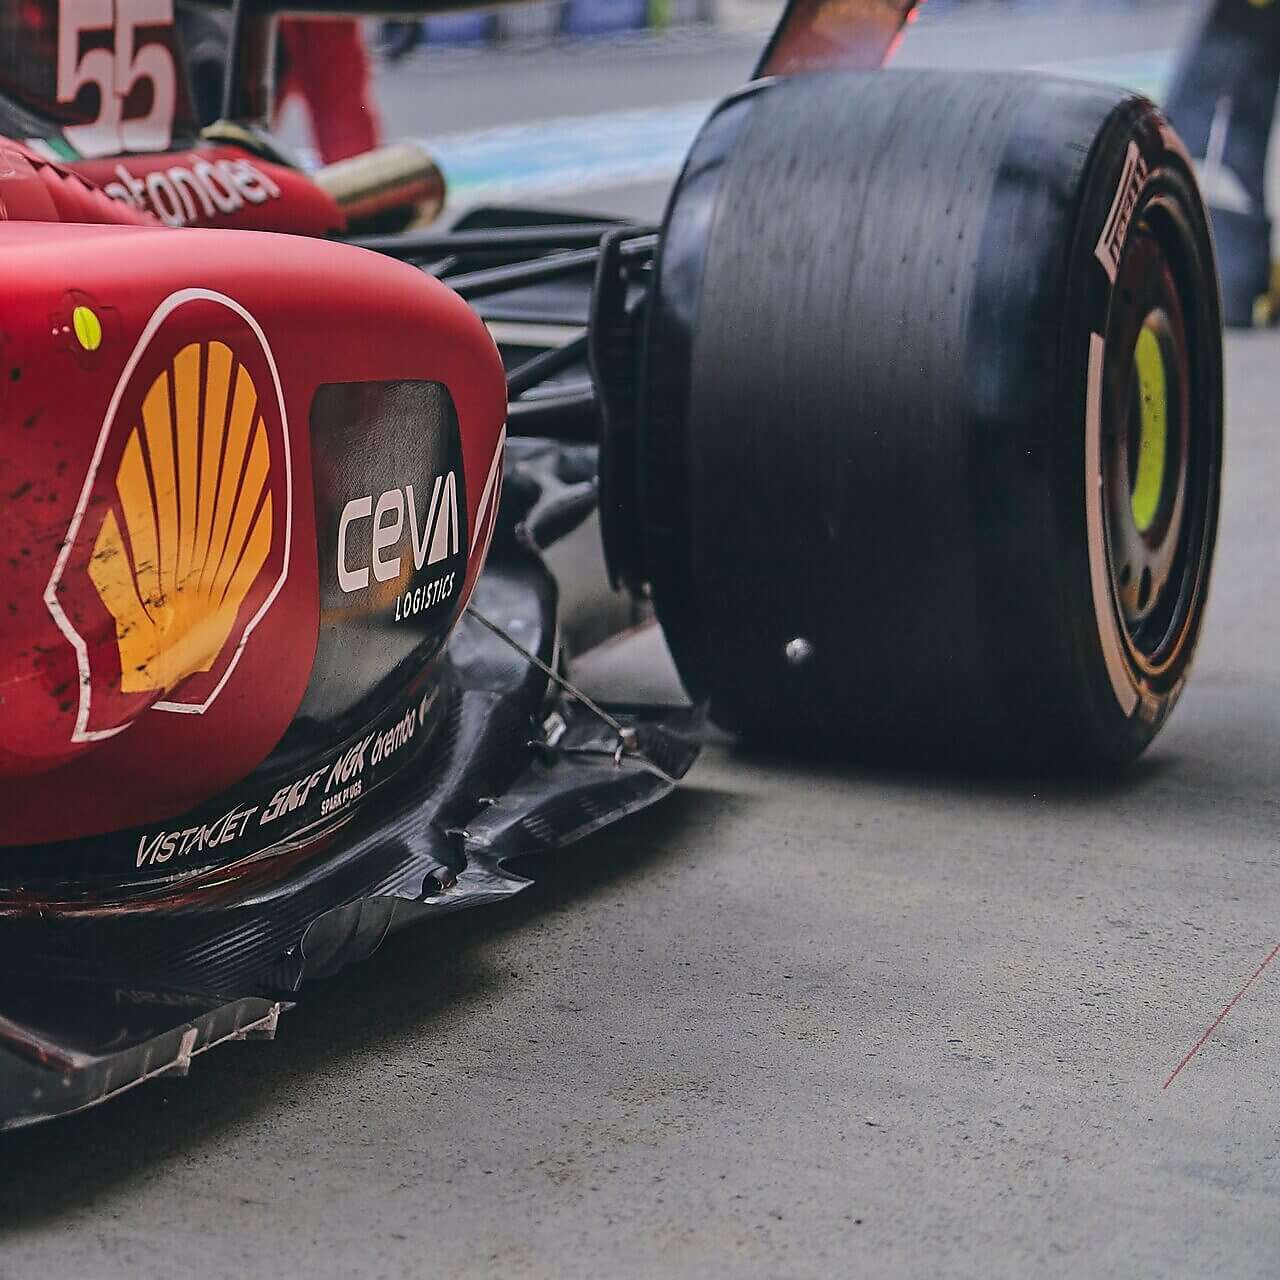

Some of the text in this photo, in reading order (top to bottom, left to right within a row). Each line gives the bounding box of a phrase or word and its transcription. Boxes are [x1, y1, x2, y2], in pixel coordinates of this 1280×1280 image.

[394, 571, 456, 622] LOGISTICS
[259, 764, 331, 826] SKF
[324, 730, 376, 794] NGK
[370, 707, 417, 766] brembo
[320, 791, 343, 816] SPARK
